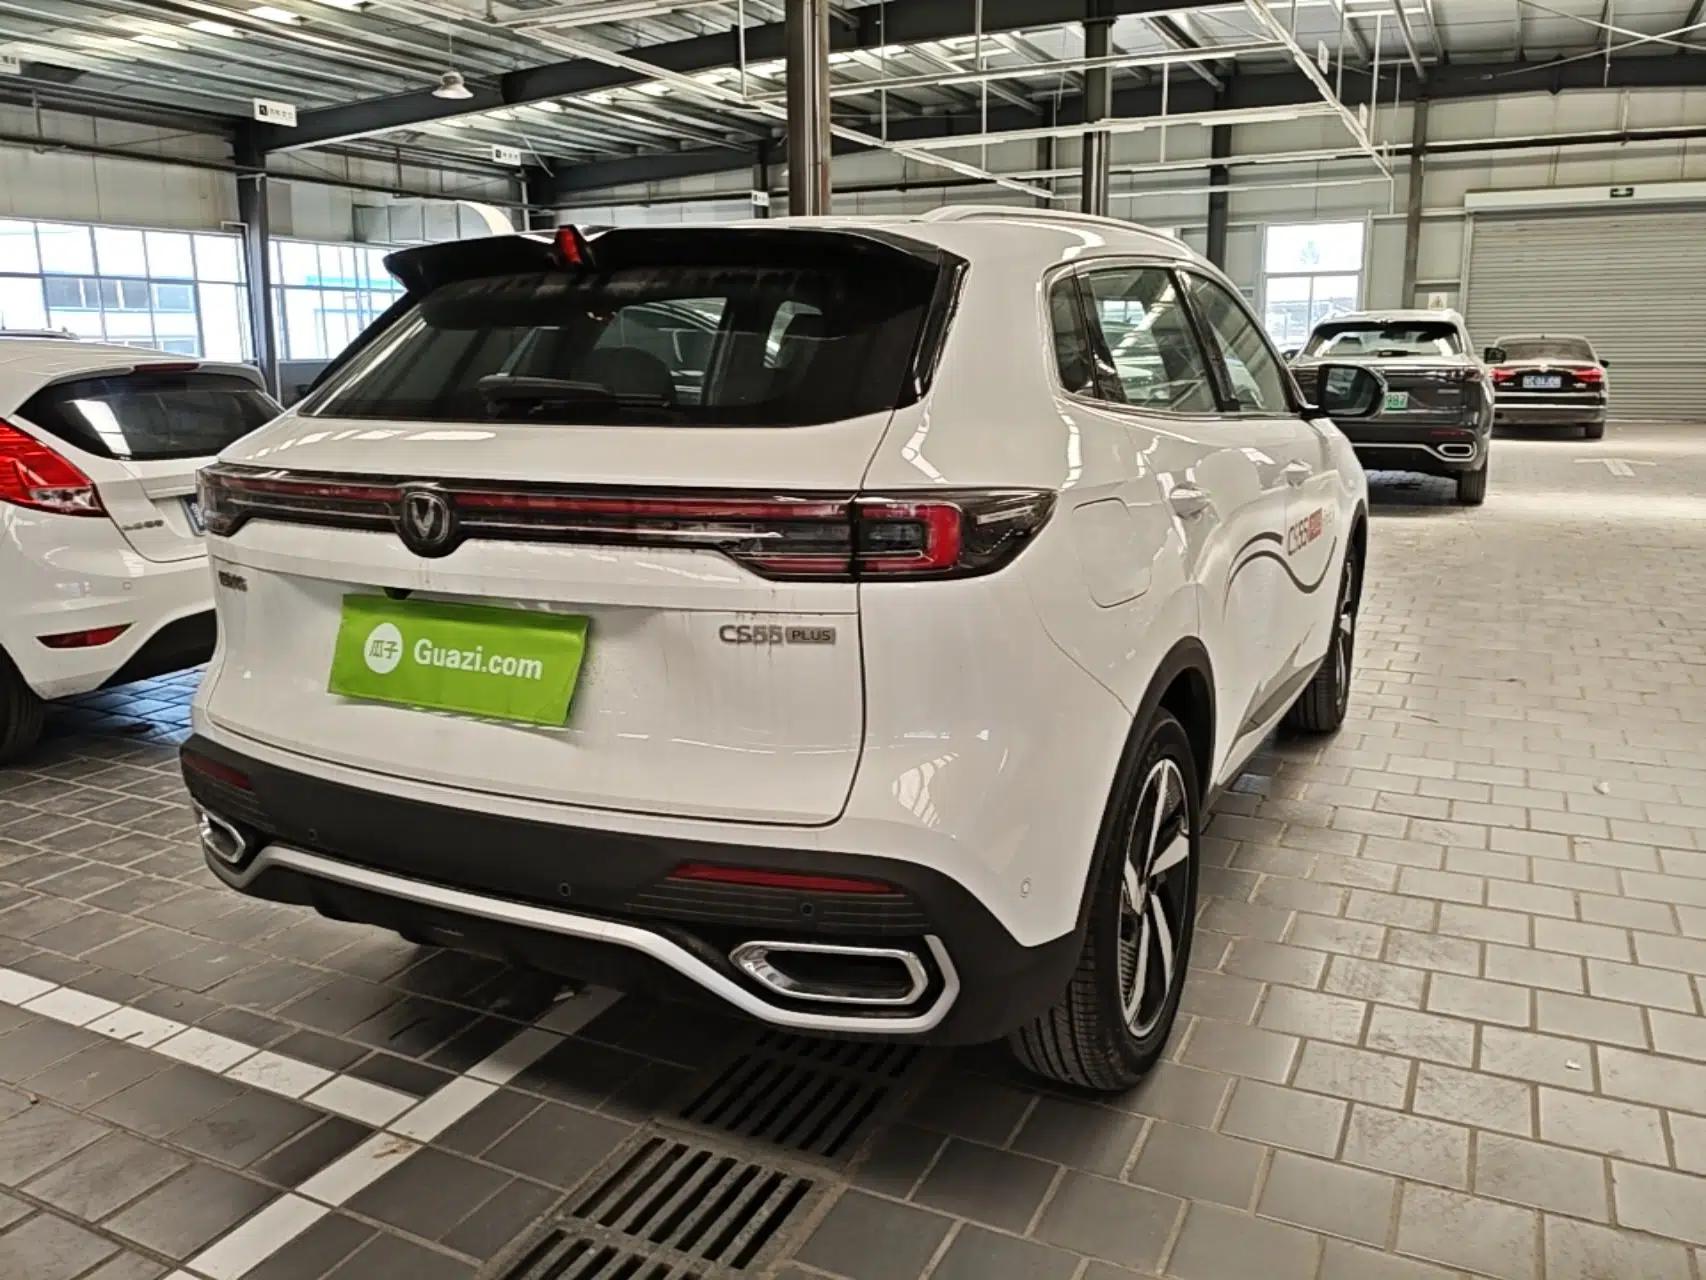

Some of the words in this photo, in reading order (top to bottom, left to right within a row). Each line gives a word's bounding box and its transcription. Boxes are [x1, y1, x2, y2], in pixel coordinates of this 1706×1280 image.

[718, 624, 782, 644] CS55
[789, 628, 833, 641] PLUS
[368, 639, 399, 660] 瓜子
[413, 638, 543, 680] Guazi.com
